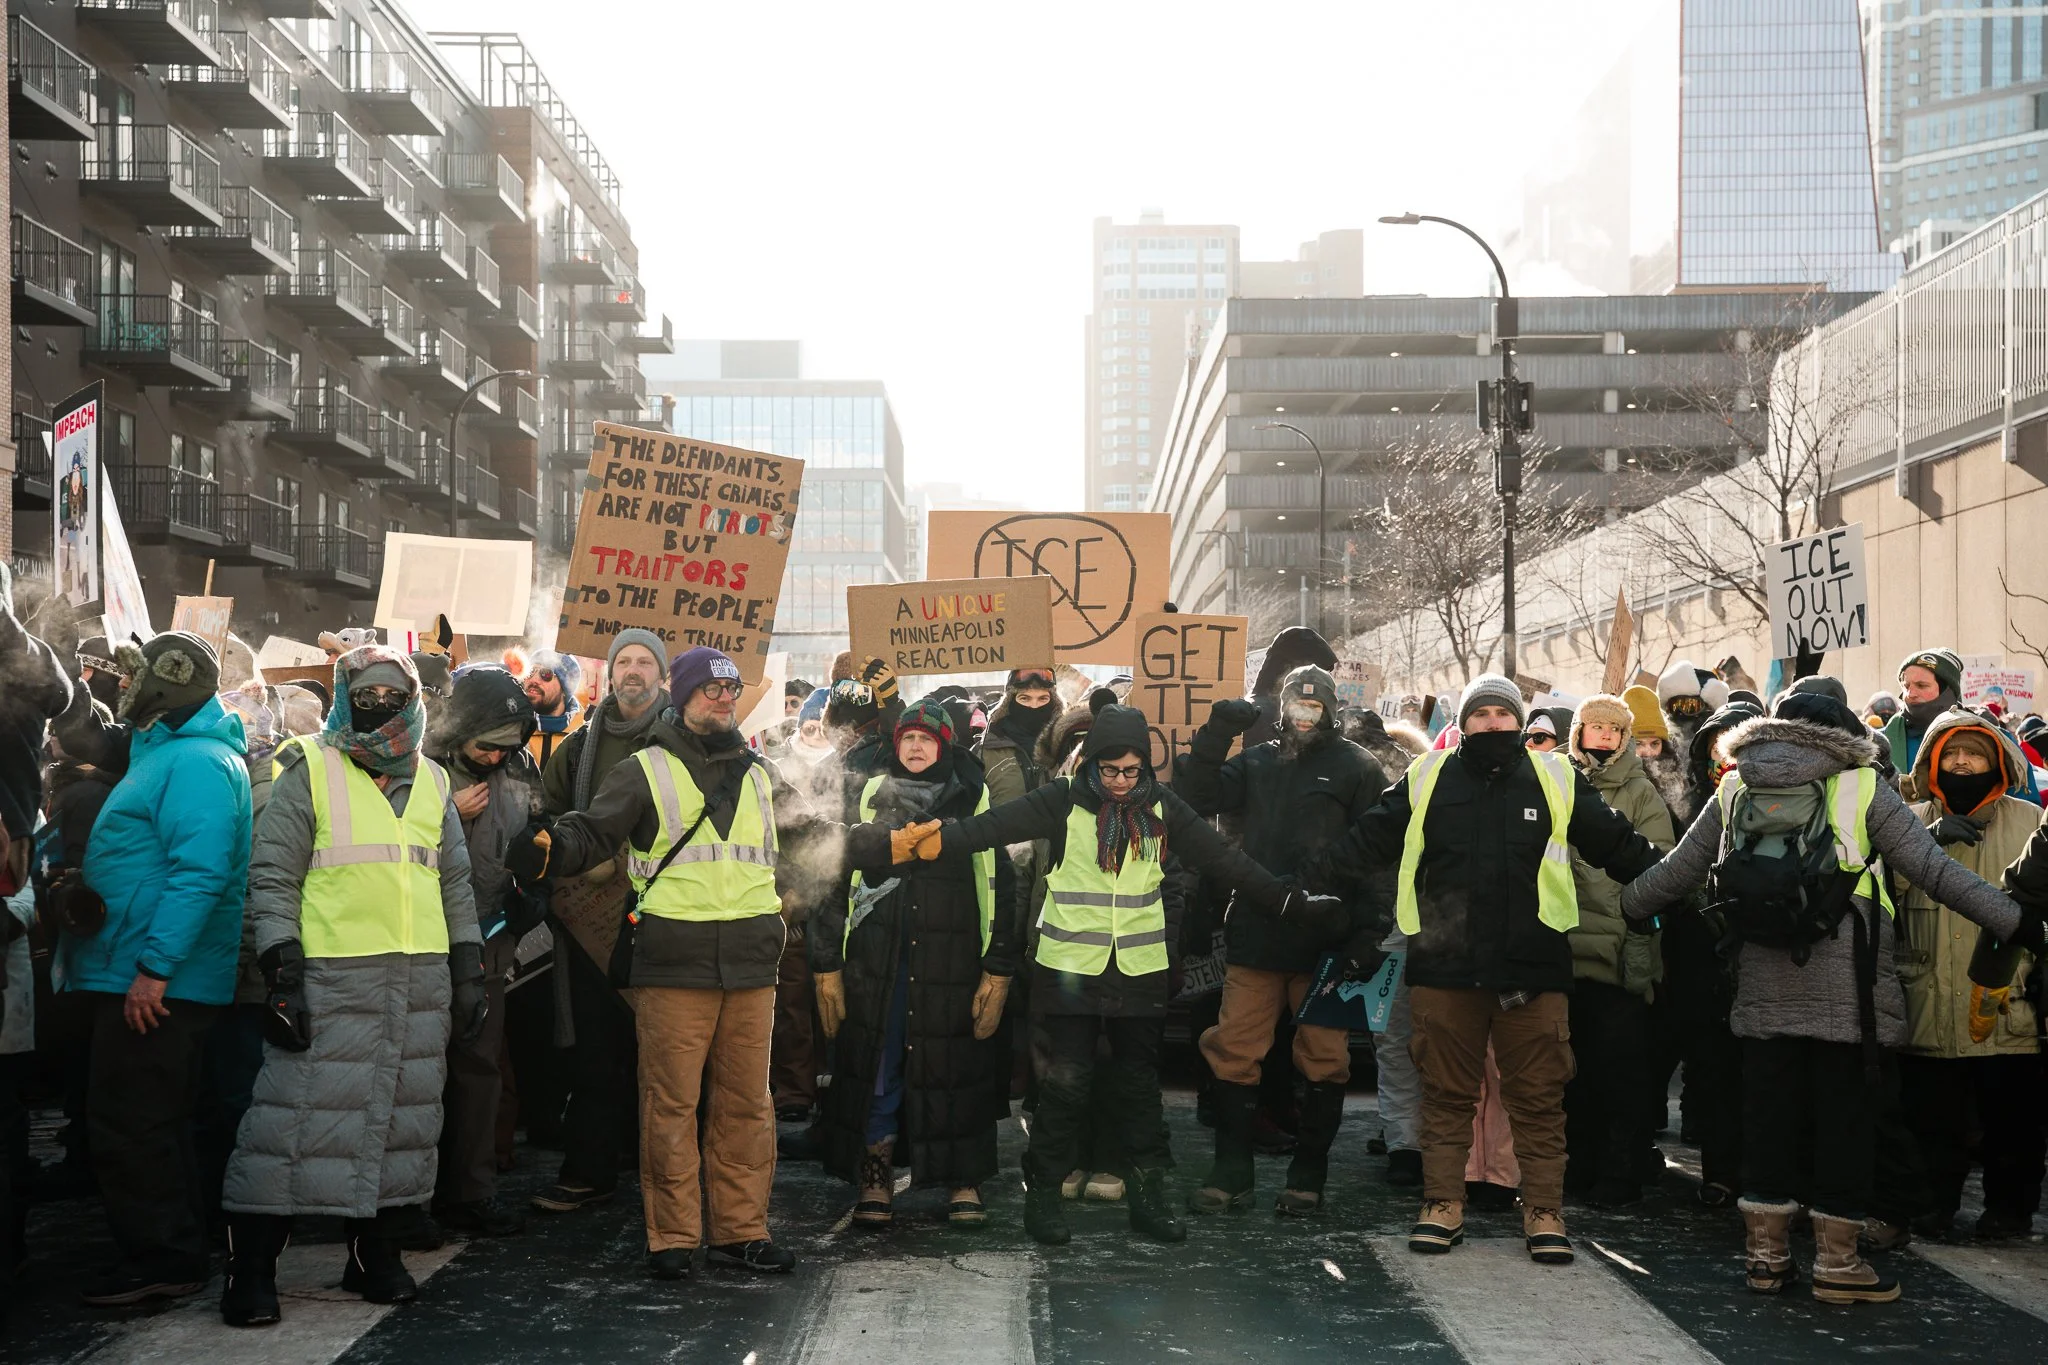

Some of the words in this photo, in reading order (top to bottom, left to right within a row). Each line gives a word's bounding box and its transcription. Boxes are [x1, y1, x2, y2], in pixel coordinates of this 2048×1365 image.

[55, 404, 95, 443] IMPEACH
[602, 428, 656, 462] "THE
[661, 442, 784, 485] DEFNDANTS,
[603, 462, 646, 490] FOR
[654, 470, 712, 500] THESE
[597, 493, 642, 520] ARE
[645, 501, 692, 527] NOT
[664, 530, 717, 554] BUT
[1780, 531, 1849, 584] ICE
[31, 560, 52, 580] MAXI
[589, 546, 749, 590] TRAITORS
[581, 584, 610, 604] TO
[616, 583, 658, 609] THE
[897, 598, 913, 621] A
[922, 593, 1005, 620] UNIQUE
[1788, 572, 1853, 620] OUT
[684, 629, 747, 652] TRIALS
[890, 618, 1005, 646] MINNEAPOLIS
[1787, 603, 1866, 656] NOW!
[896, 646, 1005, 669] REACTION
[1141, 624, 1238, 681] GET
[1144, 684, 1214, 725] TF
[1381, 700, 1399, 718] ICE
[1963, 690, 1978, 699] THE
[2004, 688, 2033, 699] CHILDREN
[1319, 957, 1334, 980] rising
[1371, 1001, 1385, 1024] for
[1379, 959, 1398, 997] Good
